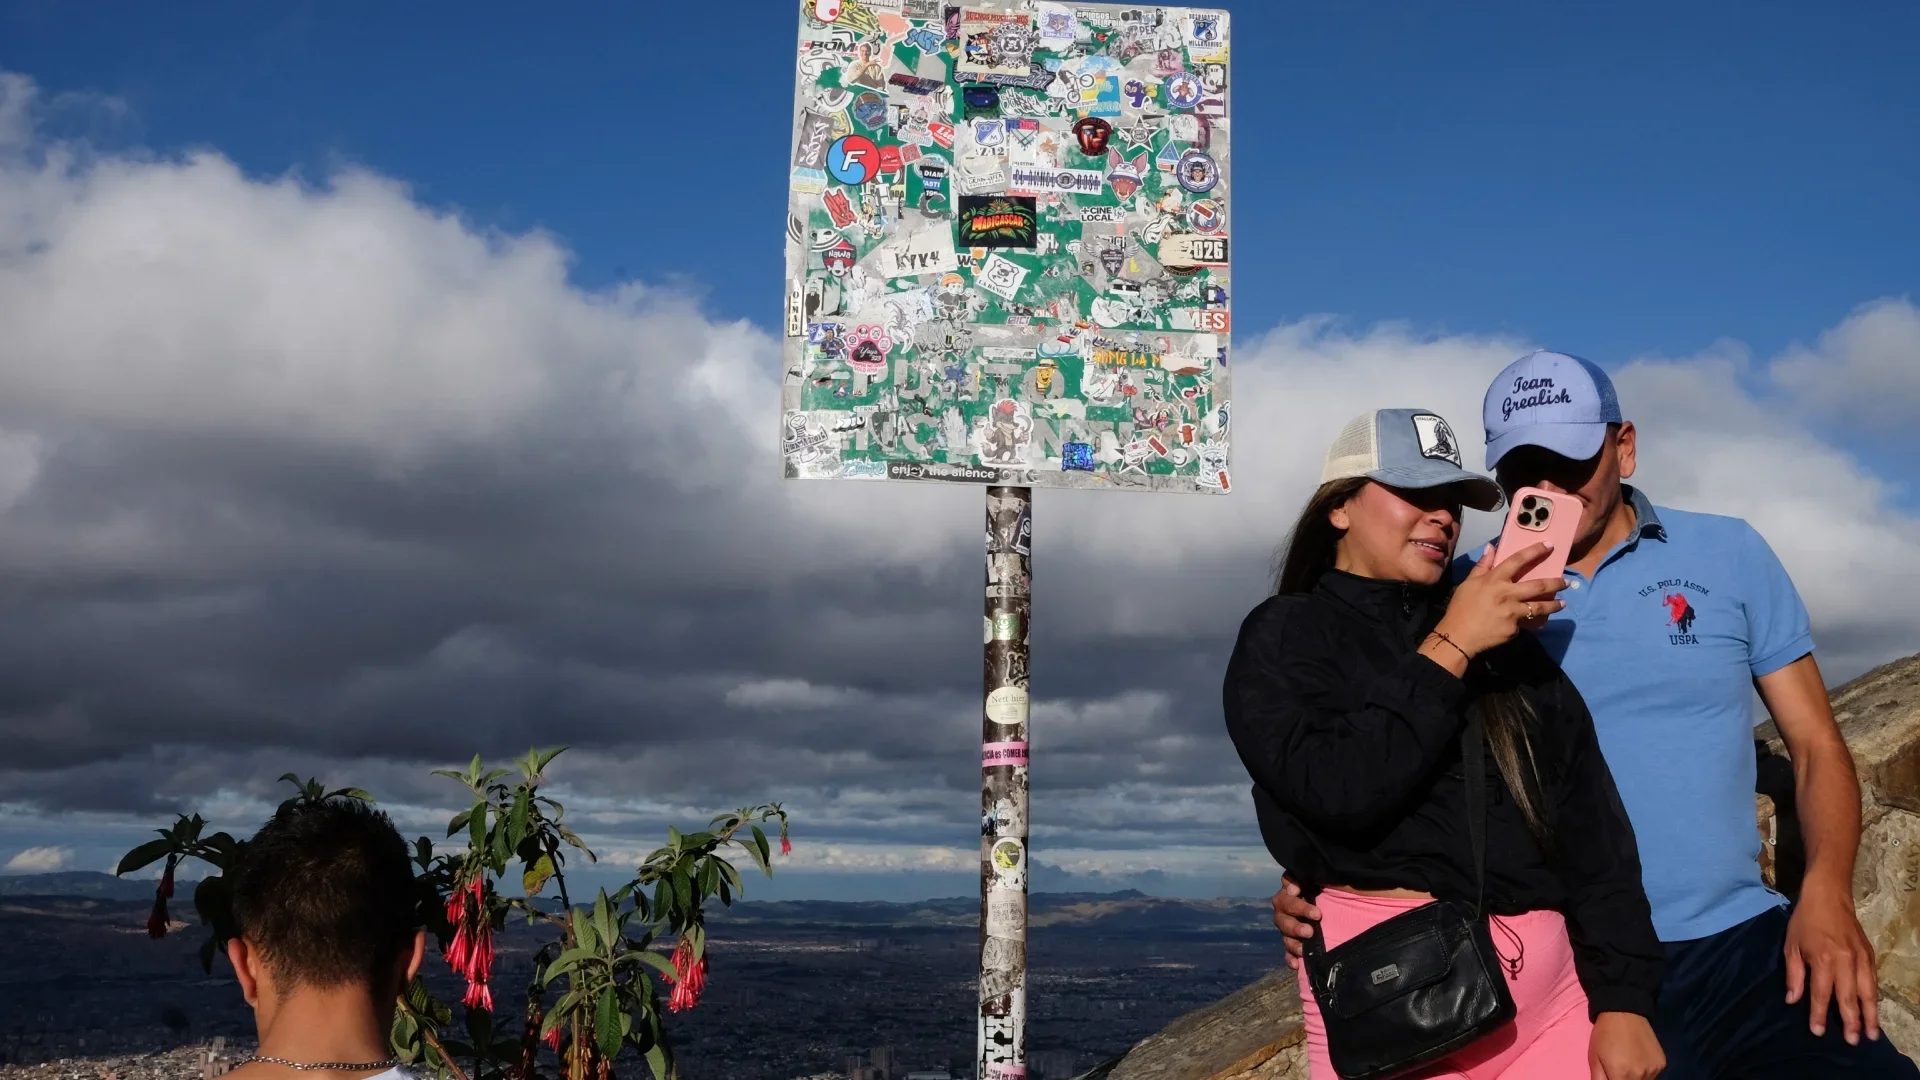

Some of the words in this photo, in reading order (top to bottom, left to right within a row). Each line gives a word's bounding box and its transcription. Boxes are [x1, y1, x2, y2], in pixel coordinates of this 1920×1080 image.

[840, 150, 866, 171] F
[1080, 214, 1113, 222] LOCAL
[1512, 376, 1555, 394] Team
[1502, 388, 1572, 422] Grealish
[929, 466, 949, 476] the
[951, 469, 995, 479] silence
[1638, 585, 1657, 598] U.S.
[1657, 578, 1682, 589] POLO
[1683, 580, 1710, 597] ASSN.
[1669, 634, 1700, 645] USPA
[991, 696, 1009, 704] Nett
